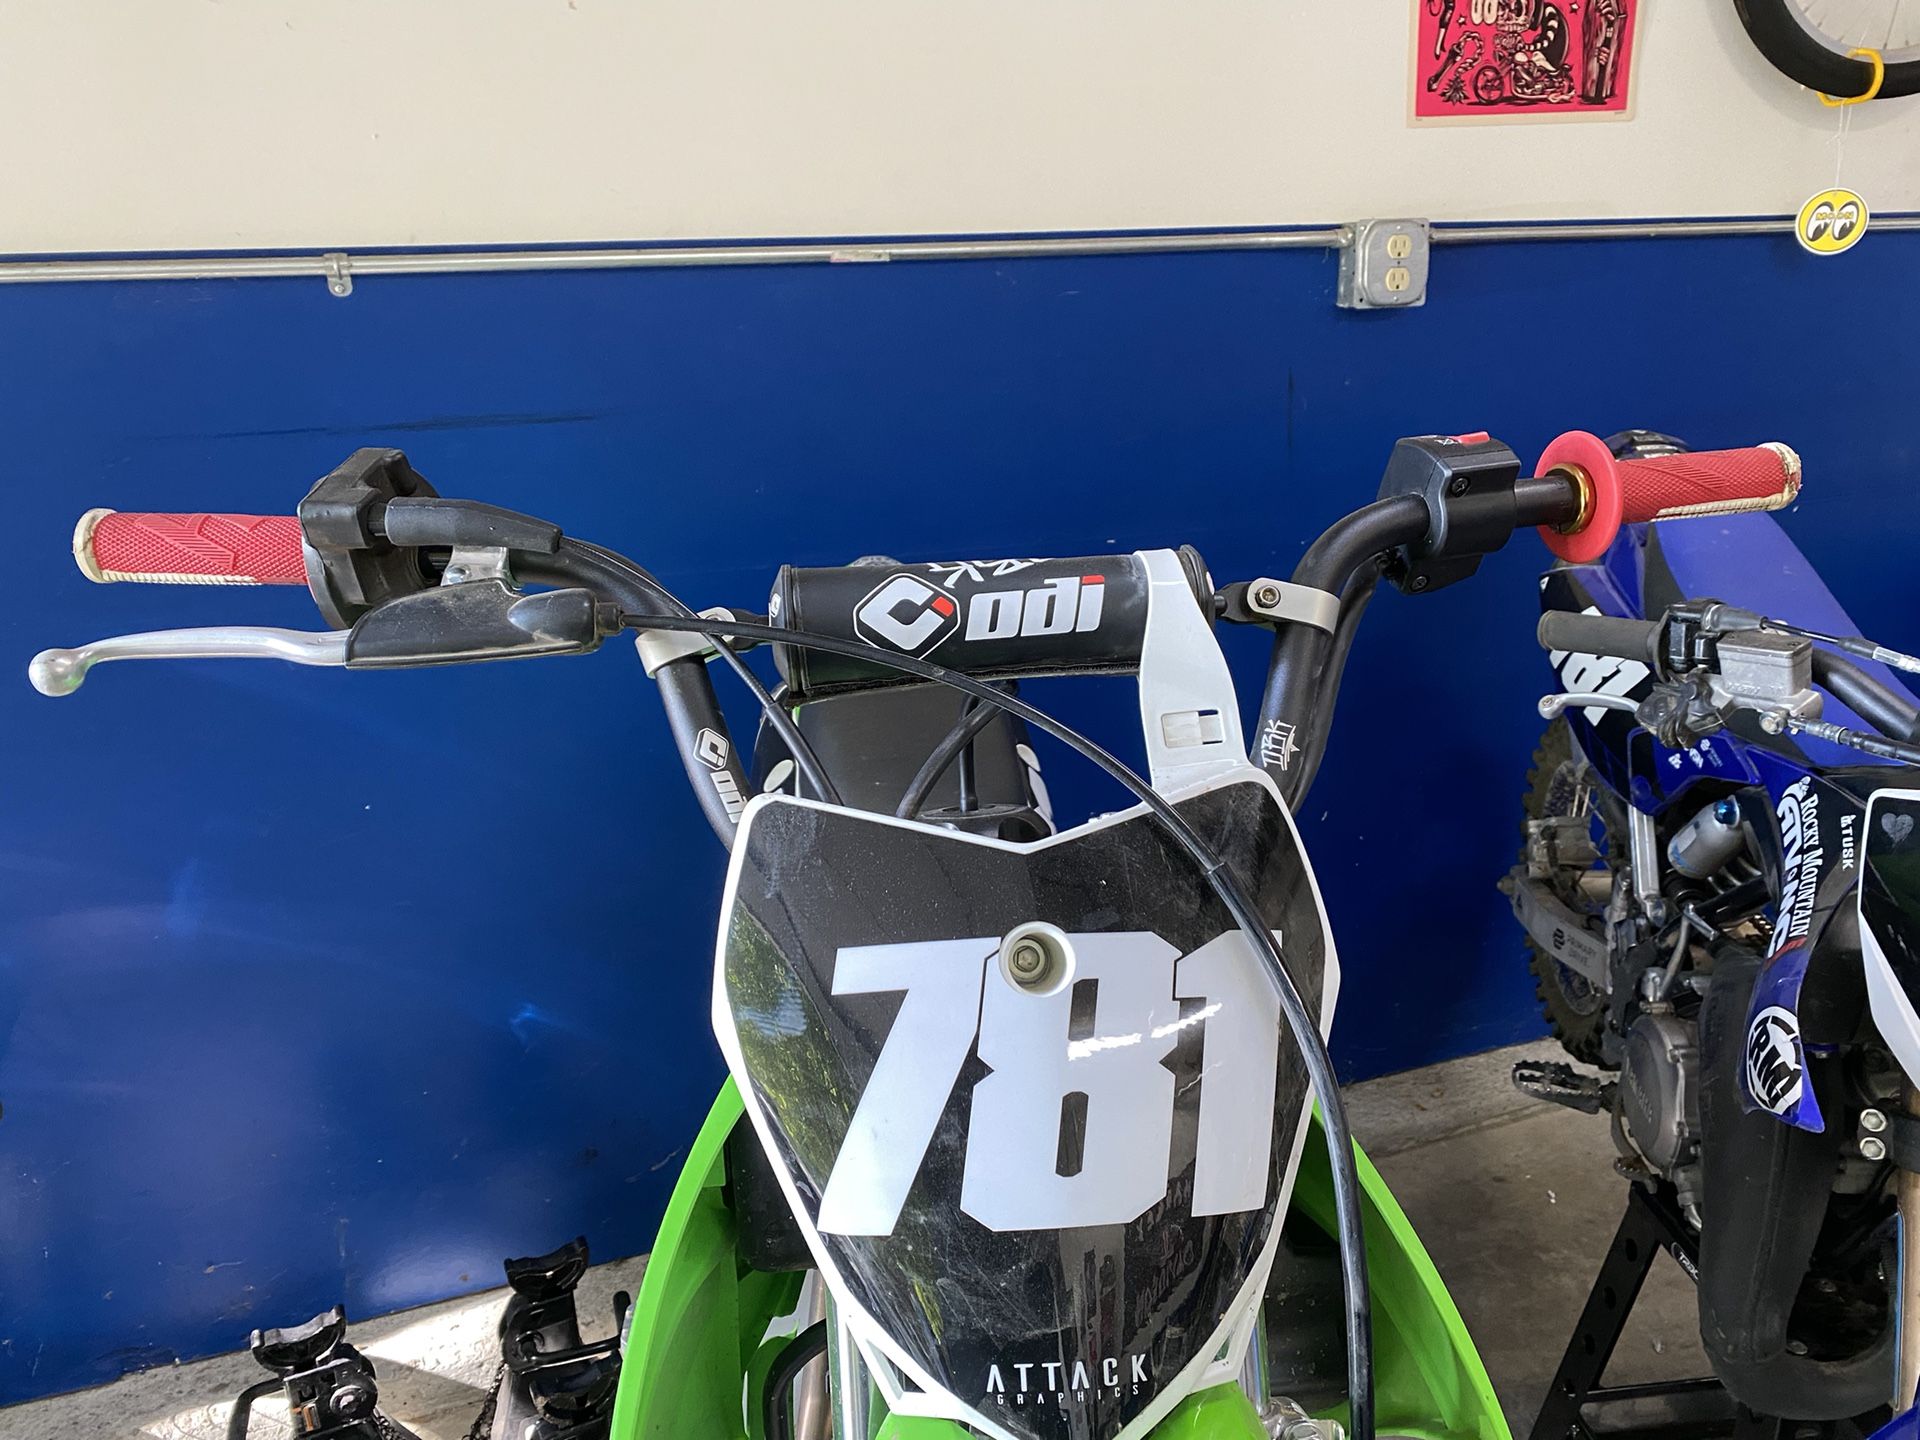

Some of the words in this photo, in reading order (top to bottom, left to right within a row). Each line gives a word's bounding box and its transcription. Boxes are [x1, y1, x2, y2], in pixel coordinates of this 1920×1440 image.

[1801, 794, 1819, 849] ROCKY
[1842, 824, 1855, 870] TUSK
[1789, 848, 1823, 937] MOUNTAIN
[817, 929, 1282, 1236] 781
[986, 1353, 1148, 1393] ATTACK
[997, 1384, 1139, 1405] GRAPHICS
